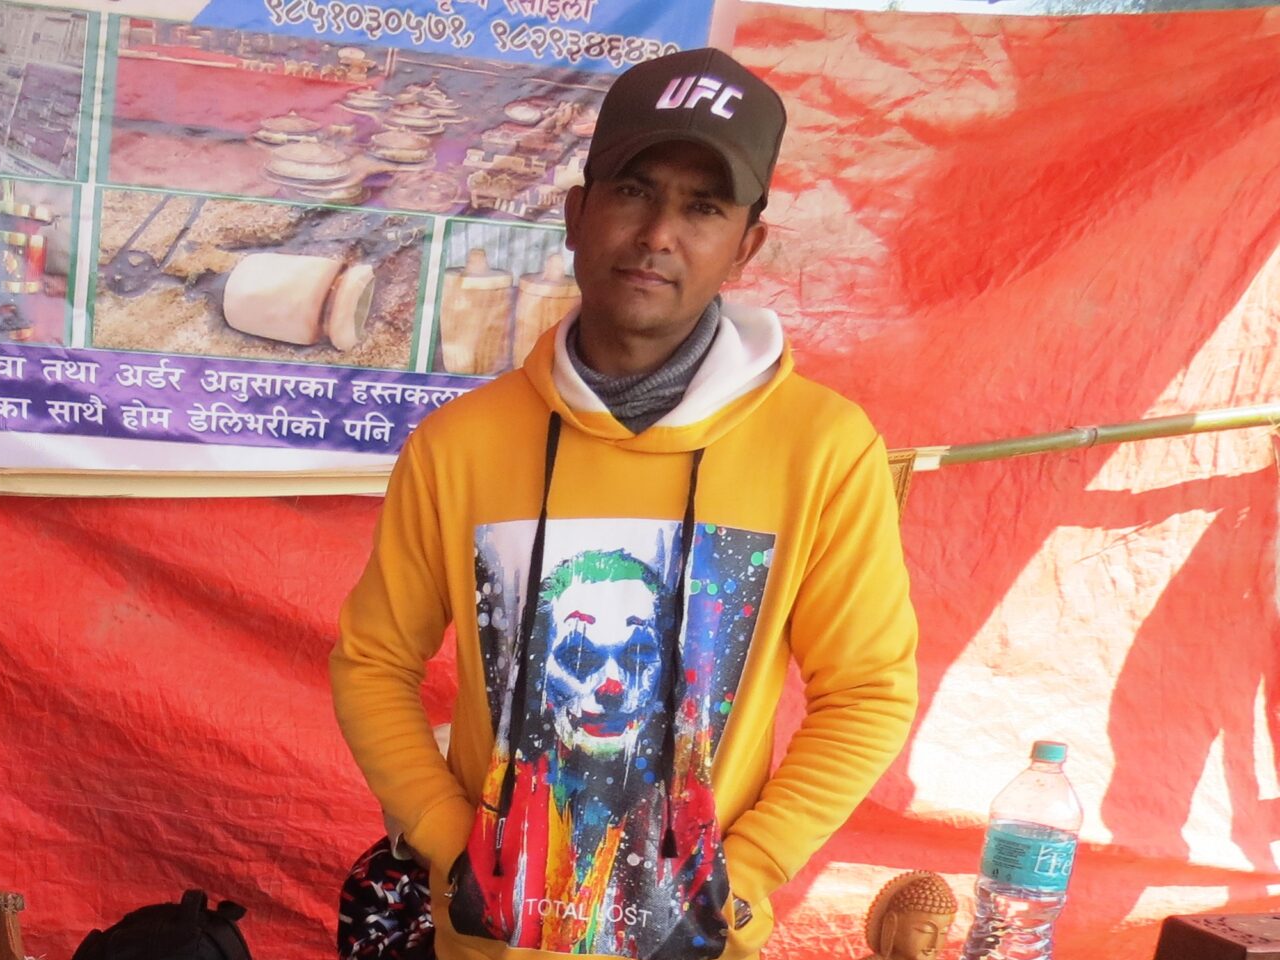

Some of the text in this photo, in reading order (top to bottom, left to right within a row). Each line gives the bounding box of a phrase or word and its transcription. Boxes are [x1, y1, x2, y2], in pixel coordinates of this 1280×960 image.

[655, 74, 744, 119] UFC
[41, 358, 100, 384] तथा
[116, 358, 185, 390] अर्डर
[201, 369, 338, 402] अनुसारका
[46, 395, 106, 425] साथै
[121, 399, 173, 430] होम
[187, 402, 329, 439] डेलिभरीको
[343, 411, 395, 443] पनि
[525, 898, 652, 928] TOTAL LOST
